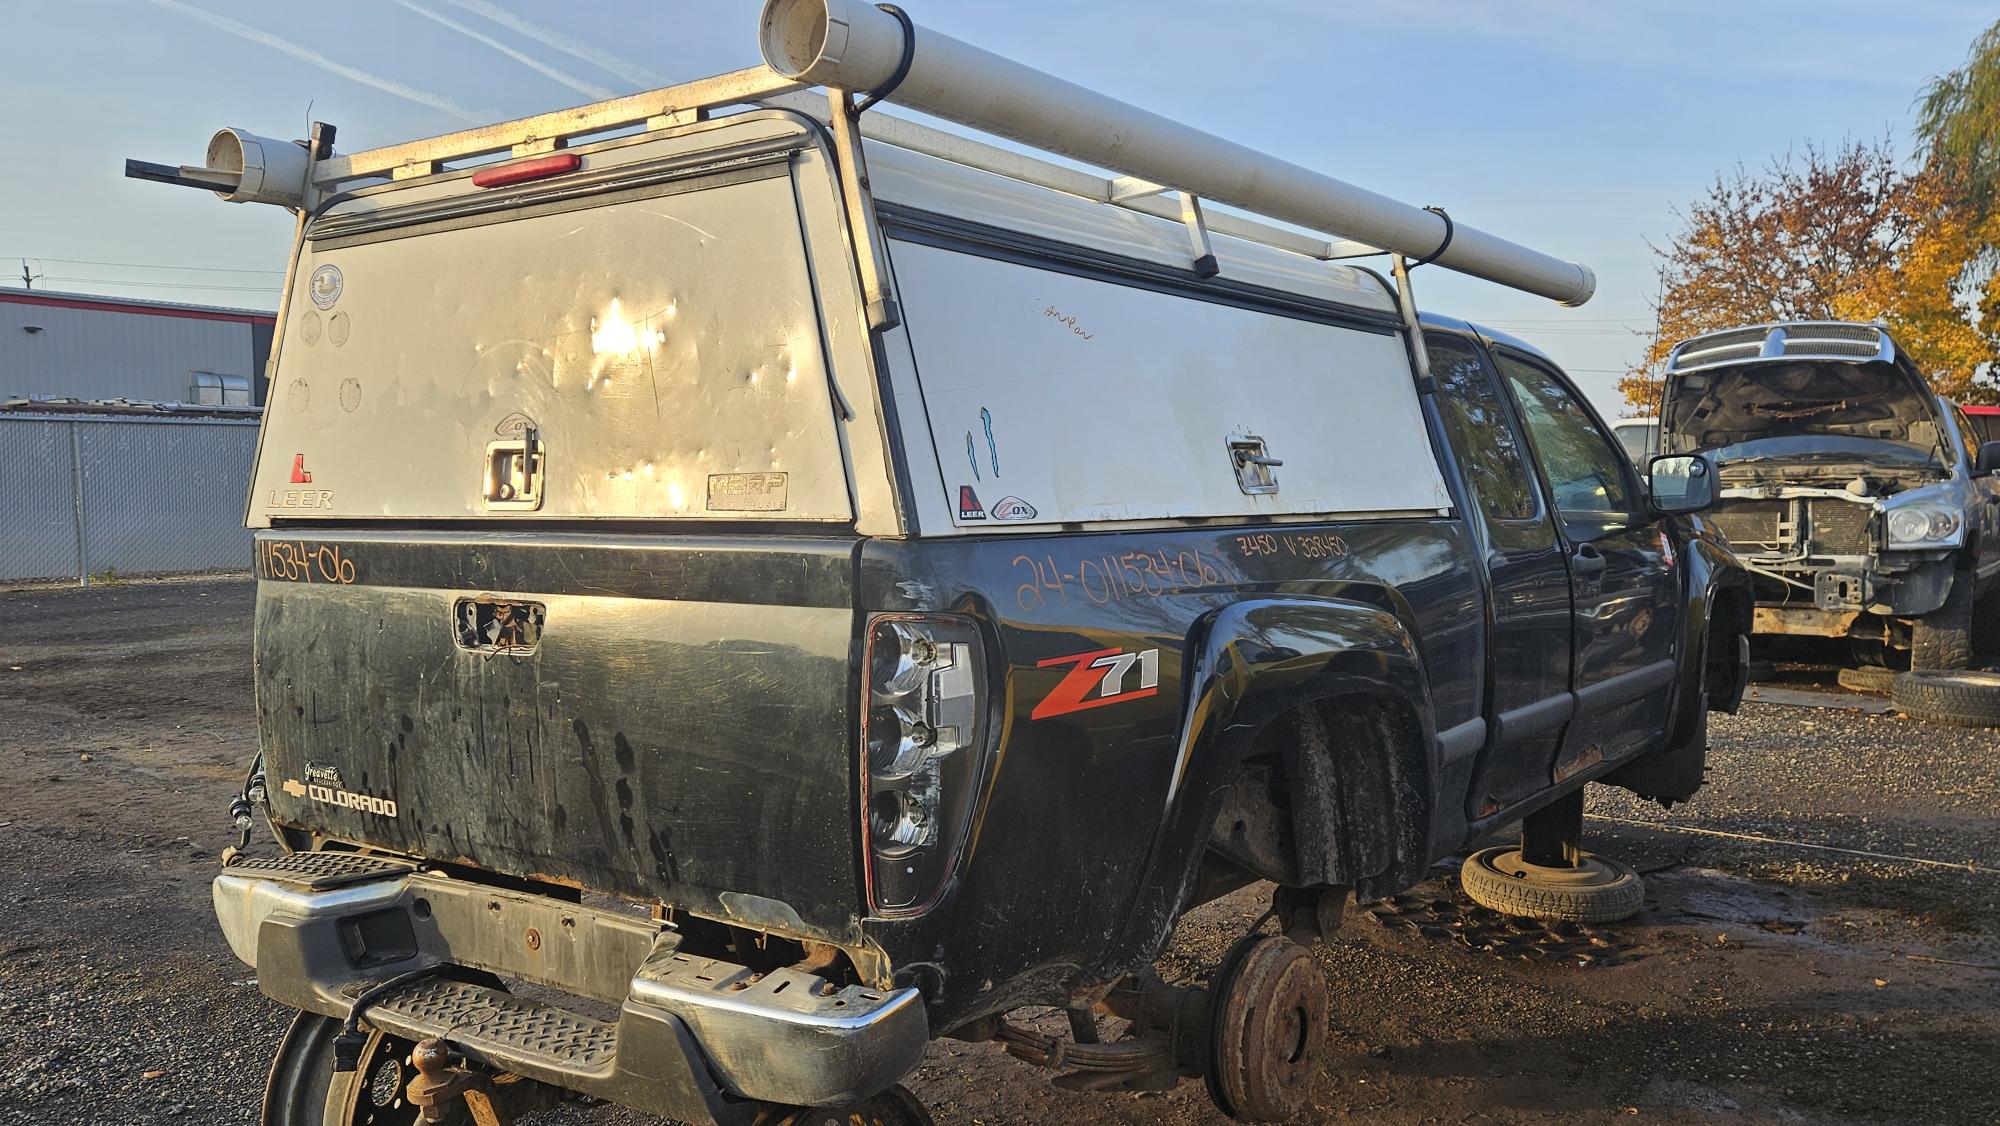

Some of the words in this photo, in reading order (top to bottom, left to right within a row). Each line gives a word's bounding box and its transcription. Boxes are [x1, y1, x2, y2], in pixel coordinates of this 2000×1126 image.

[266, 489, 335, 511] LEER
[961, 510, 985, 518] LEER
[261, 540, 355, 584] 11534-06
[1012, 549, 1218, 611] 24-011534-06
[1031, 647, 1159, 720] Z71
[308, 785, 398, 818] COLORADO
